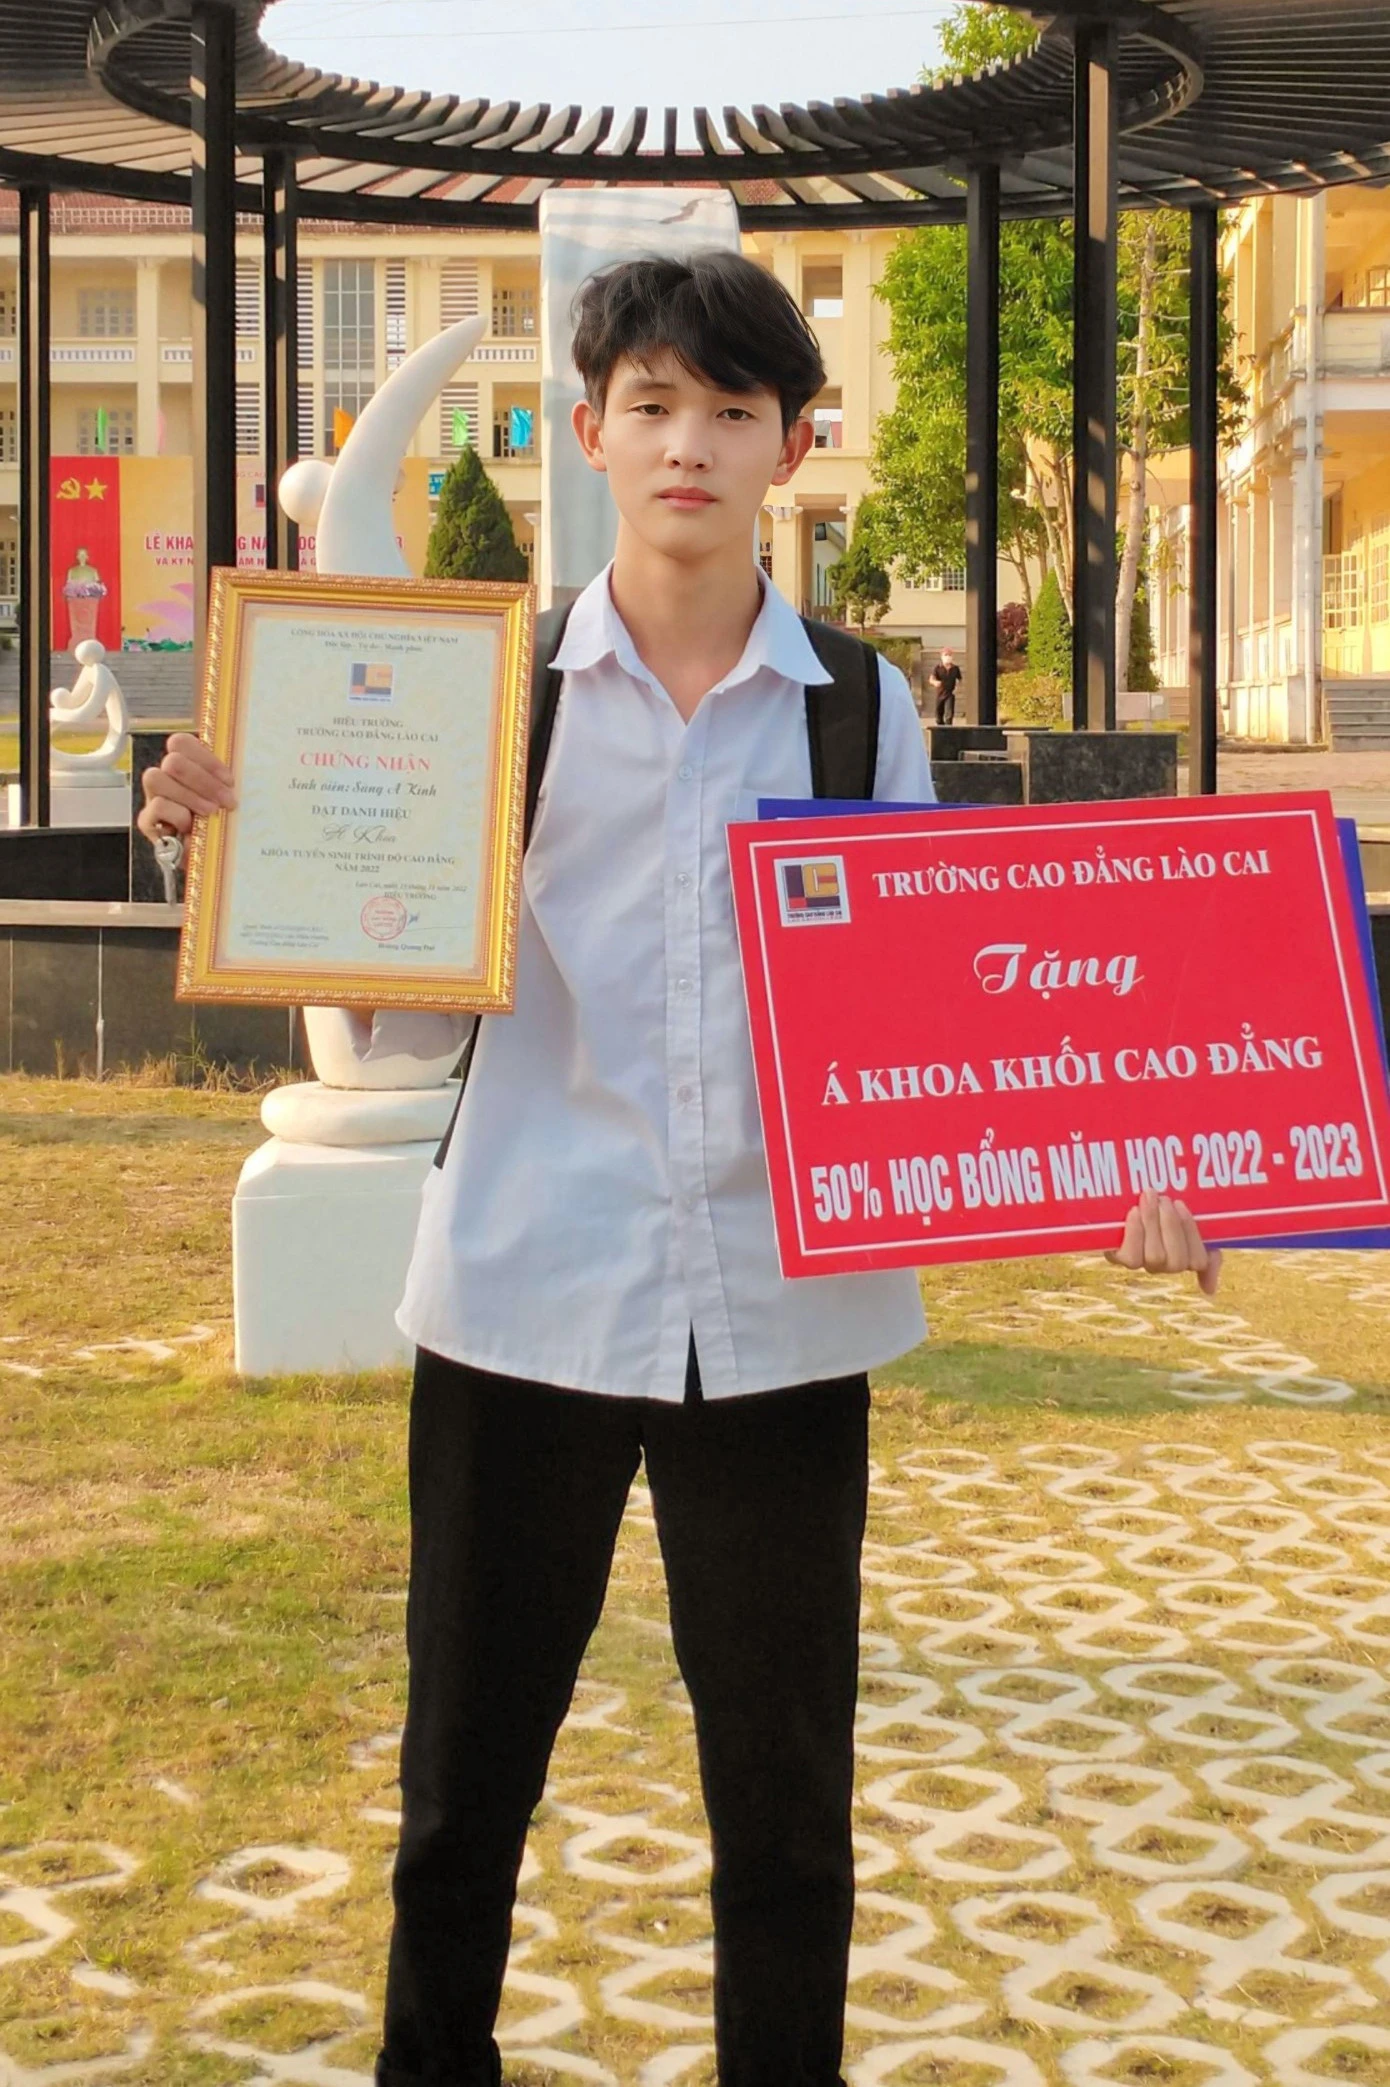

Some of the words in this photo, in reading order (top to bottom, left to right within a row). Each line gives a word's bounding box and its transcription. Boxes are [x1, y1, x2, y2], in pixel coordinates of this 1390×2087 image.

[166, 535, 194, 550] KHA
[342, 729, 363, 739] CAO
[299, 749, 369, 770] CHỨNG
[376, 752, 431, 775] NHẬN
[341, 806, 377, 817] DANH
[380, 806, 411, 820] HIỆU
[360, 864, 380, 873] 2022
[873, 860, 1000, 898] TRƯỜNG
[1007, 861, 1065, 890] CAO
[1072, 844, 1152, 886] ĐẲNG
[1160, 847, 1216, 881] LÀO
[1223, 849, 1271, 876] CAI
[972, 943, 1145, 999] Tặng
[821, 1061, 850, 1106] Á
[857, 1061, 984, 1103] KHOA
[990, 1034, 1105, 1092] KHỐI
[1114, 1044, 1197, 1083] CAO
[1206, 1021, 1322, 1076] ĐẲNG
[810, 1160, 883, 1223] 50%
[888, 1153, 952, 1226] HỌC
[957, 1127, 1045, 1209] BỔNG
[1047, 1130, 1122, 1201] NĂM
[1192, 1129, 1269, 1189] 2022
[1271, 1152, 1285, 1165] -
[1289, 1121, 1364, 1181] 2023
